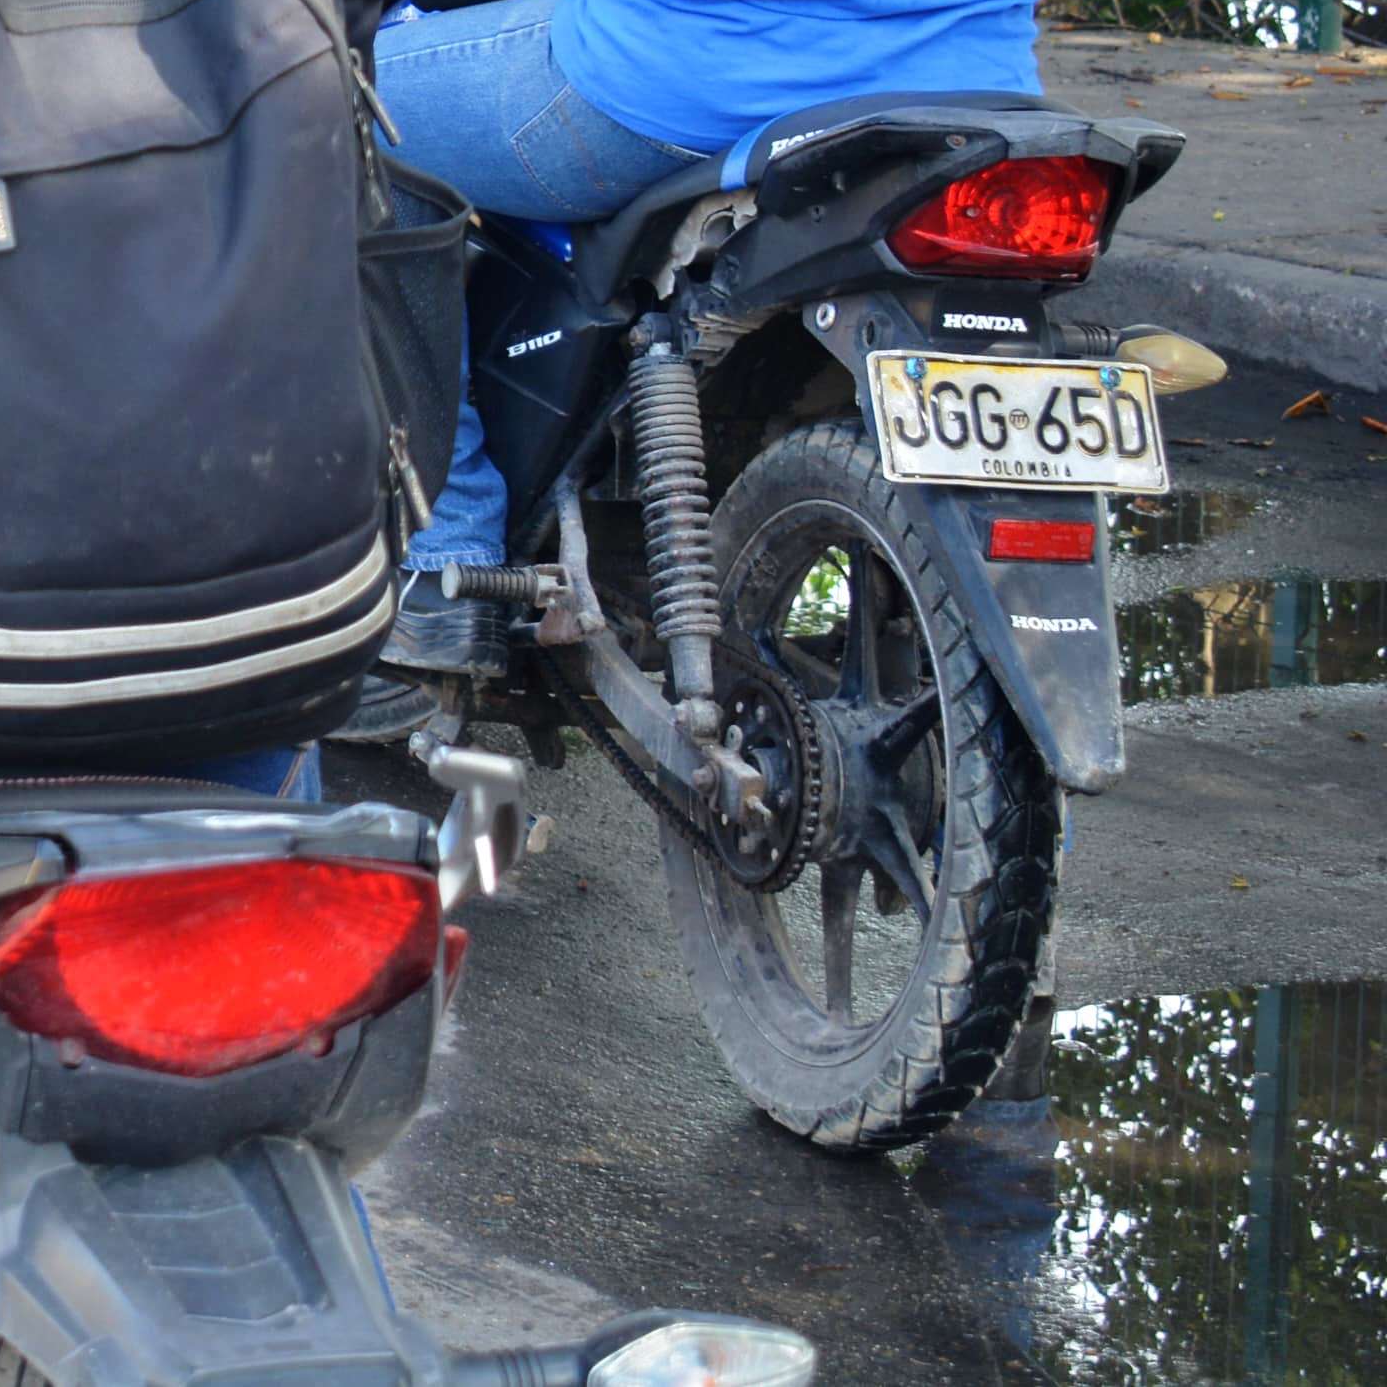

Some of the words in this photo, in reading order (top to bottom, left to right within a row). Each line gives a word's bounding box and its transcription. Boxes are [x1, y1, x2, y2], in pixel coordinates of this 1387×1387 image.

[942, 312, 1027, 333] HONDA
[893, 377, 1009, 451] JGG
[1035, 386, 1149, 459] 65D
[982, 458, 1073, 478] COLOMBIA
[1010, 614, 1098, 632] HONDA
